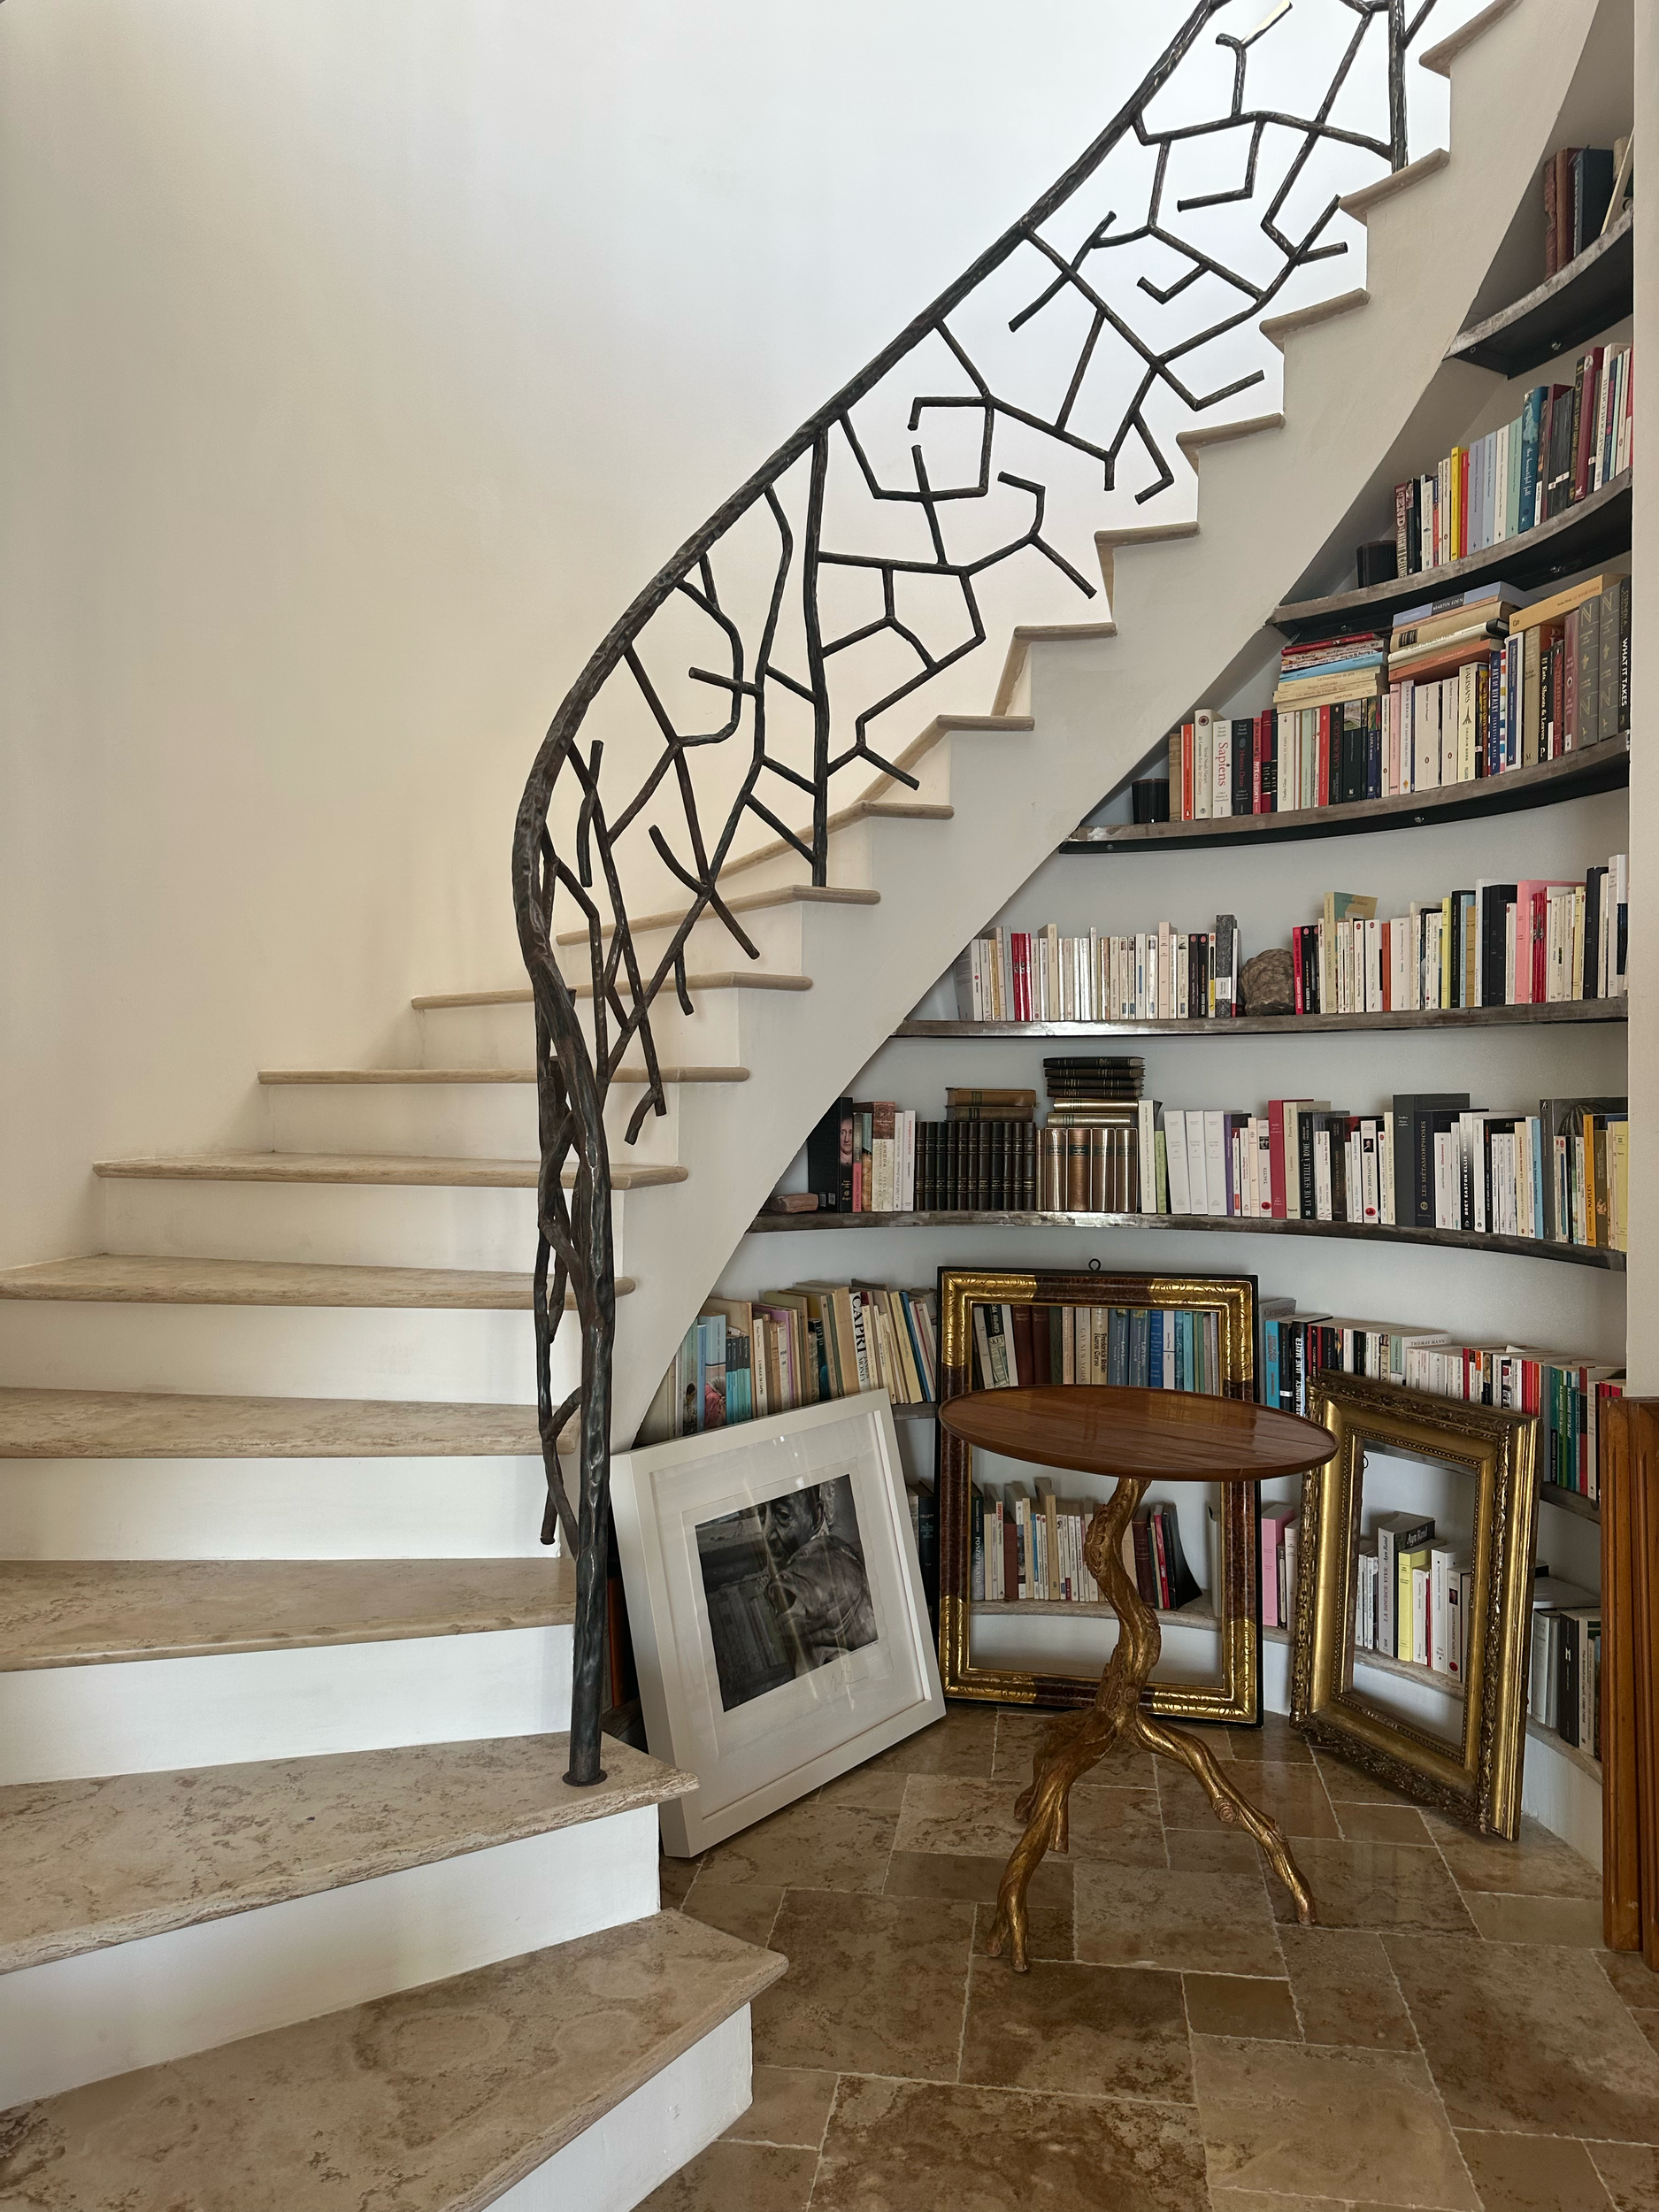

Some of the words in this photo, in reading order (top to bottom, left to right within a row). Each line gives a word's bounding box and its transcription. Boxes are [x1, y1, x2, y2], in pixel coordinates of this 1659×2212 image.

[1598, 380, 1608, 456] HEDGEHOGGING
[1524, 459, 1532, 484] beautiful
[1432, 602, 1451, 611] MARTIN
[1621, 667, 1627, 676] IT
[1216, 742, 1230, 786] Sapiens
[852, 1295, 866, 1353] CAPRI
[1406, 1532, 1417, 1546] Ayn
[1417, 1526, 1428, 1540] Rand
